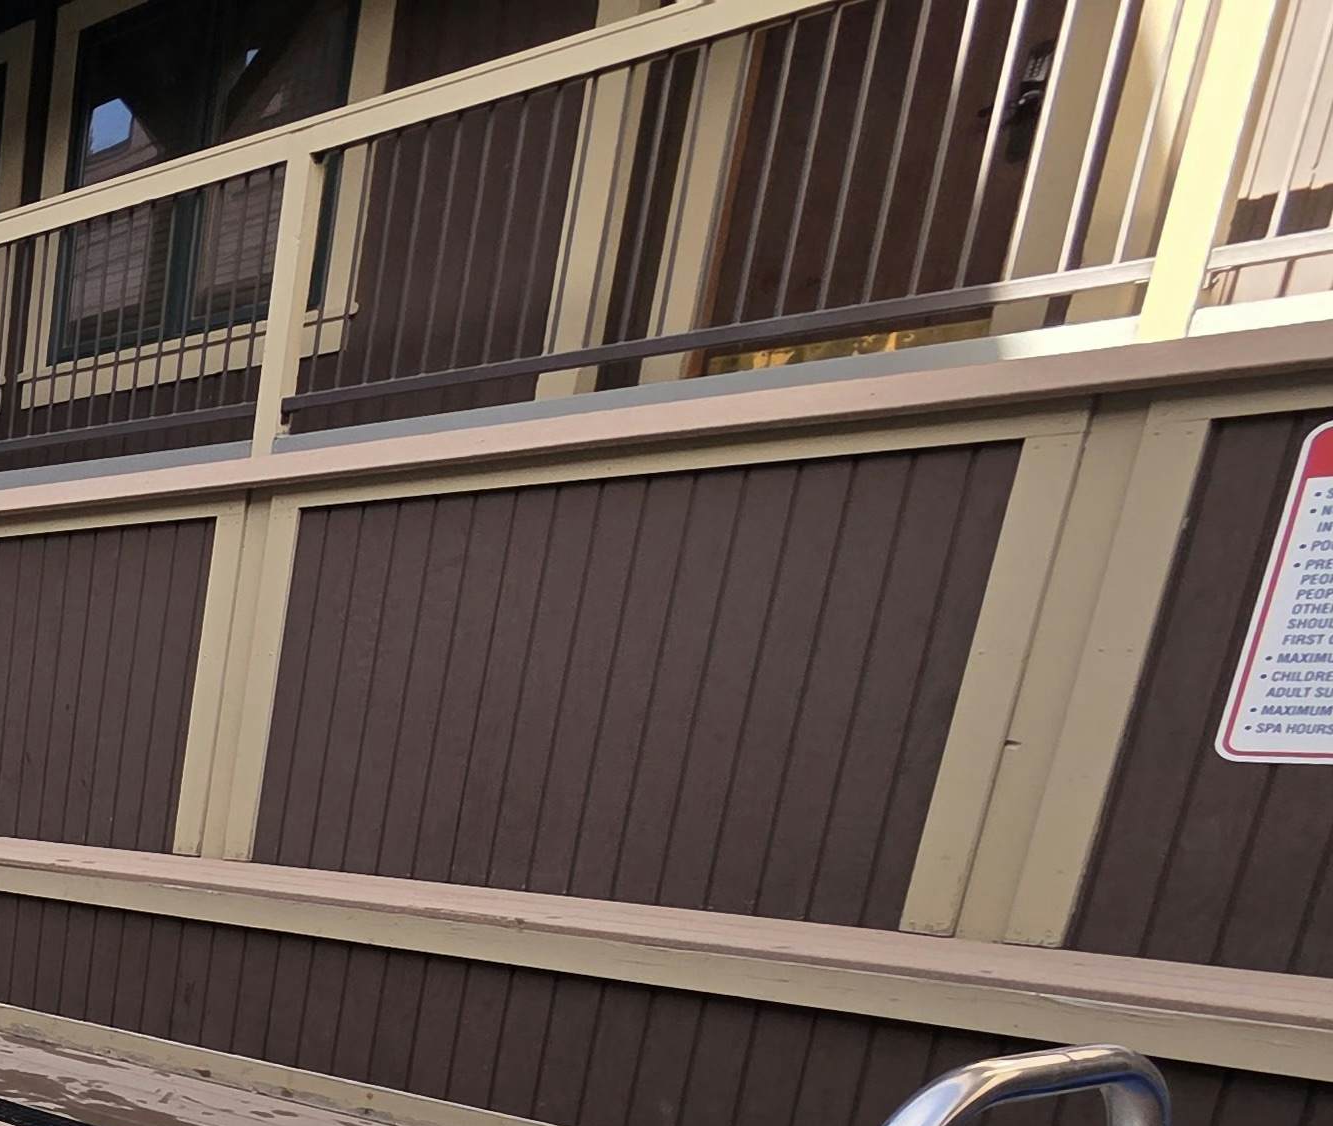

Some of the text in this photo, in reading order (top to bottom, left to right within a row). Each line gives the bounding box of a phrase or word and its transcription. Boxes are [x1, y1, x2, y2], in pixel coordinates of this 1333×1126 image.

[1311, 540, 1333, 551] PO
[1282, 635, 1325, 646] FIRST
[1266, 687, 1312, 698] ADULT
[1261, 705, 1333, 716] MAXIMUM
[1256, 723, 1333, 735] SPA HOURS
